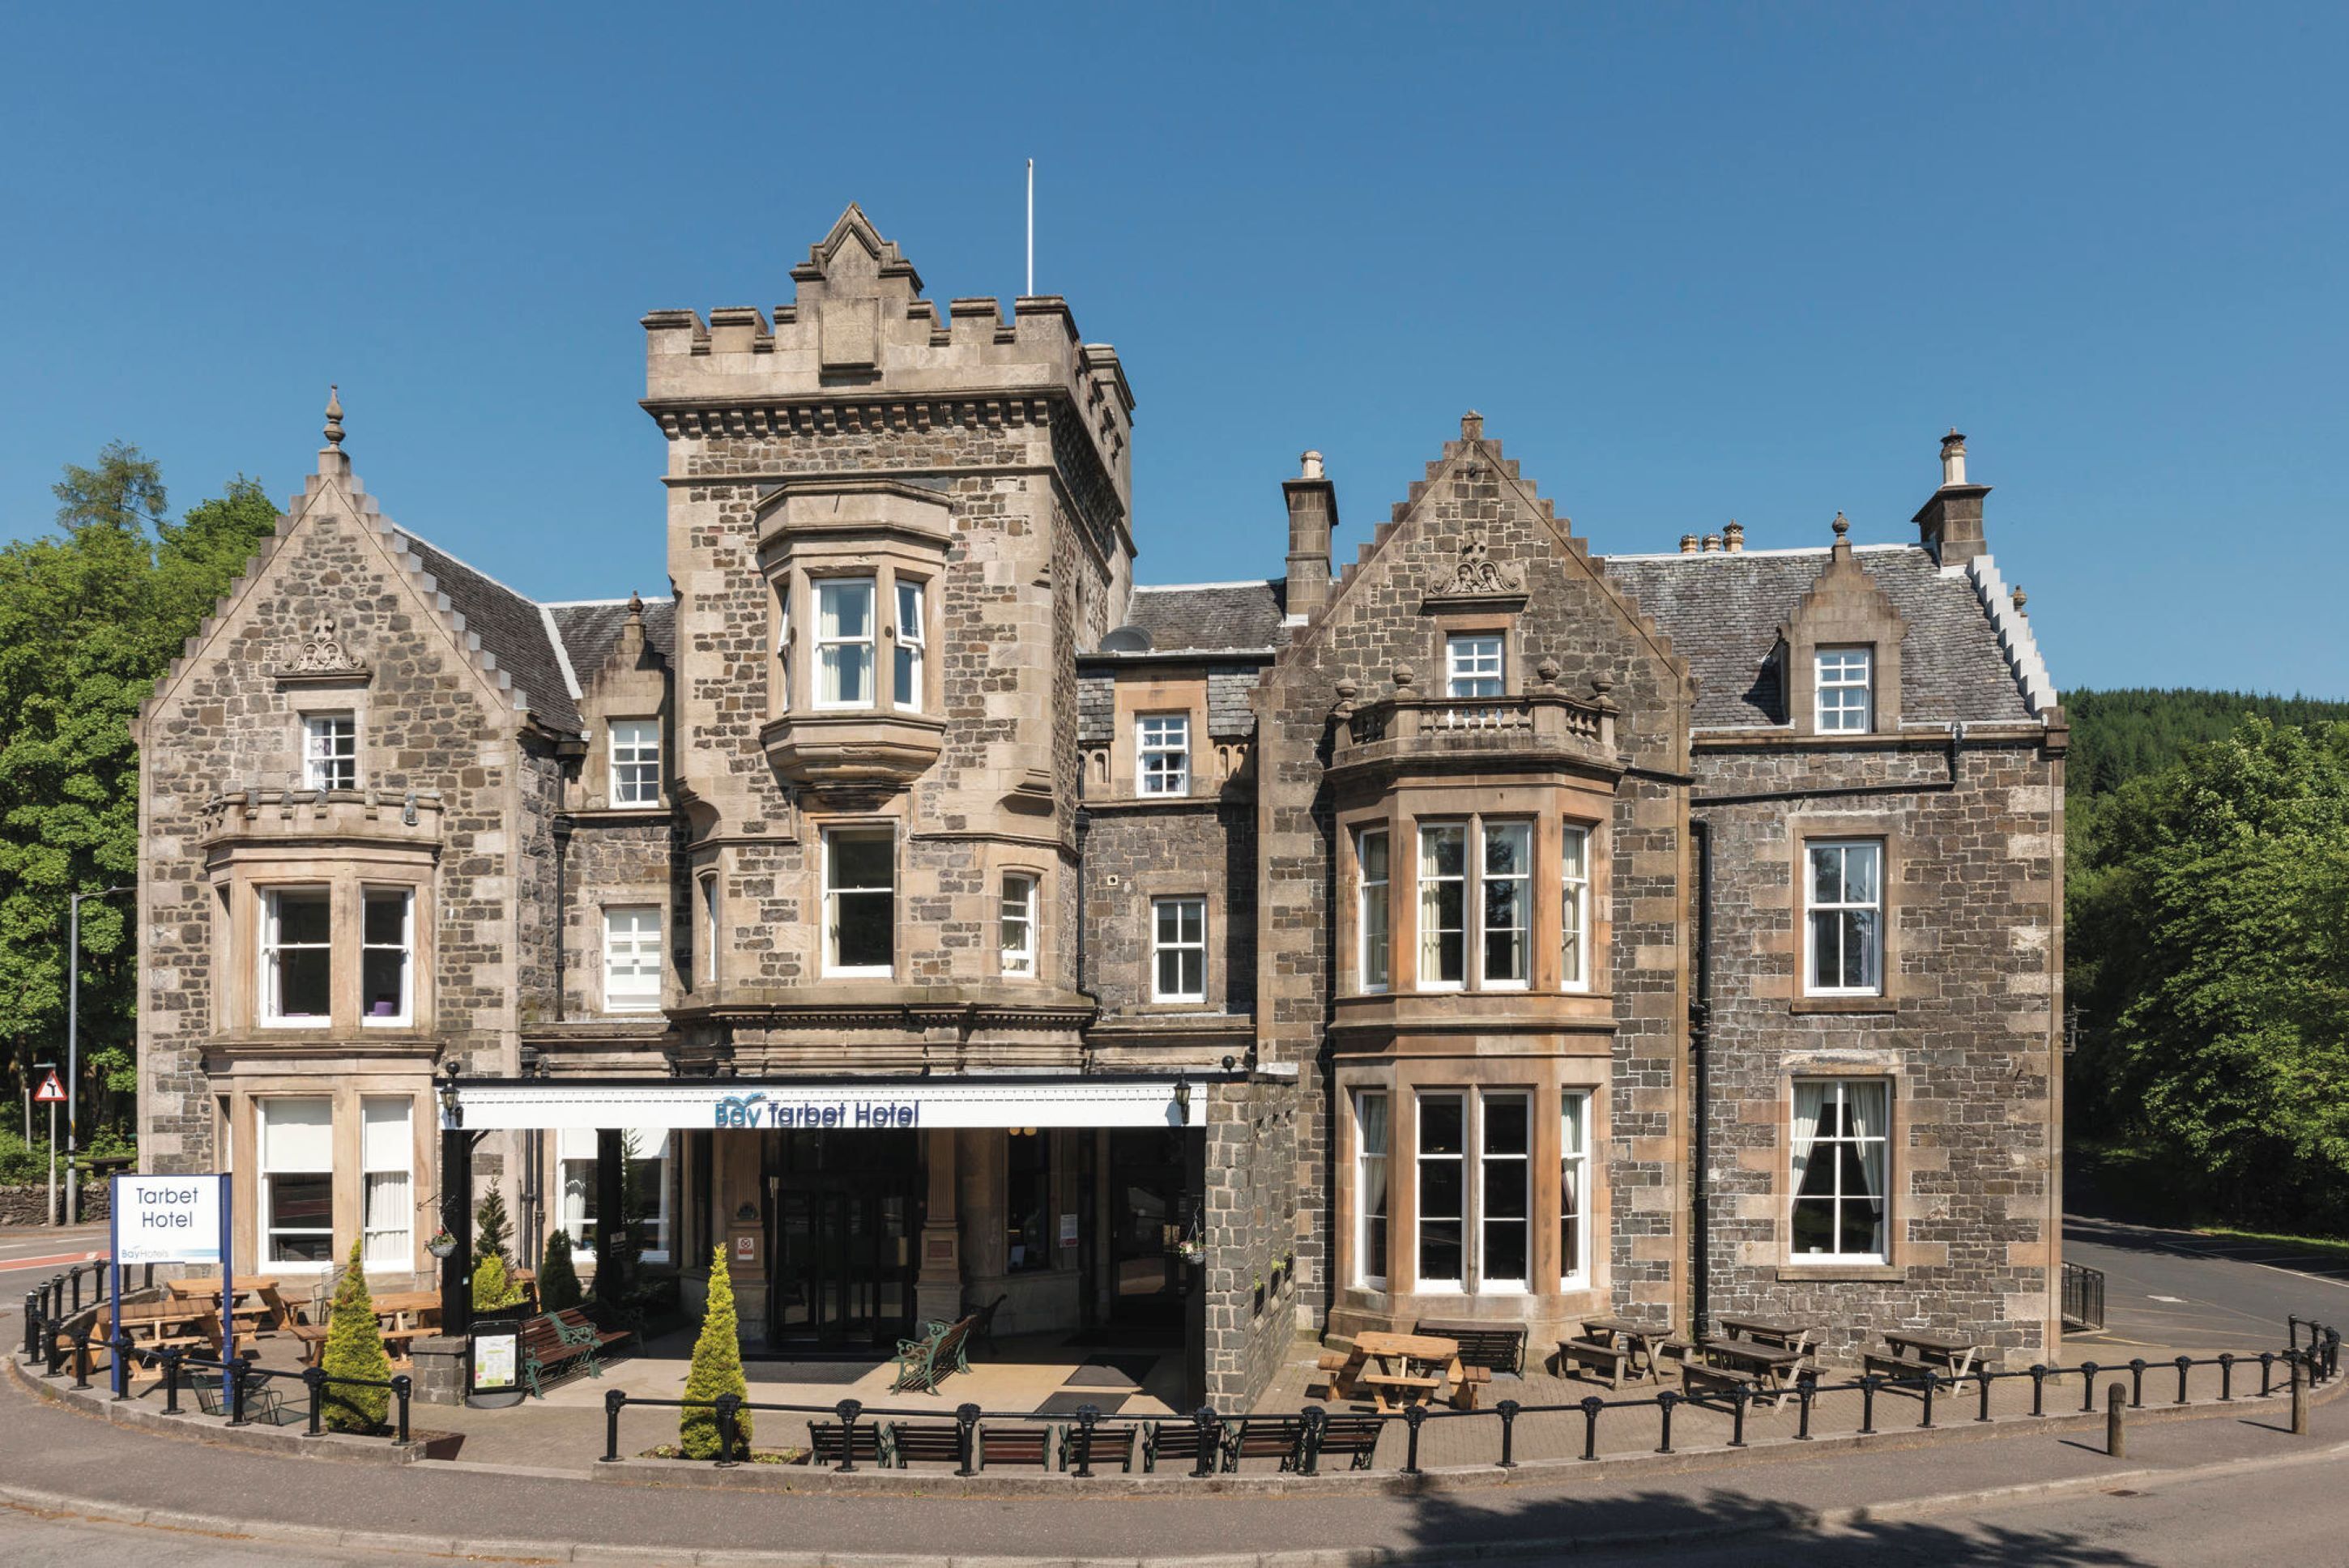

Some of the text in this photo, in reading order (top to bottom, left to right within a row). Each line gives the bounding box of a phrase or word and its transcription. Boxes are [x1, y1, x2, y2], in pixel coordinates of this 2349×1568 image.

[769, 1102, 846, 1127] Tarbet
[855, 1101, 920, 1127] Hotel
[136, 1187, 198, 1204] Tarbet
[143, 1211, 193, 1228] Hotel
